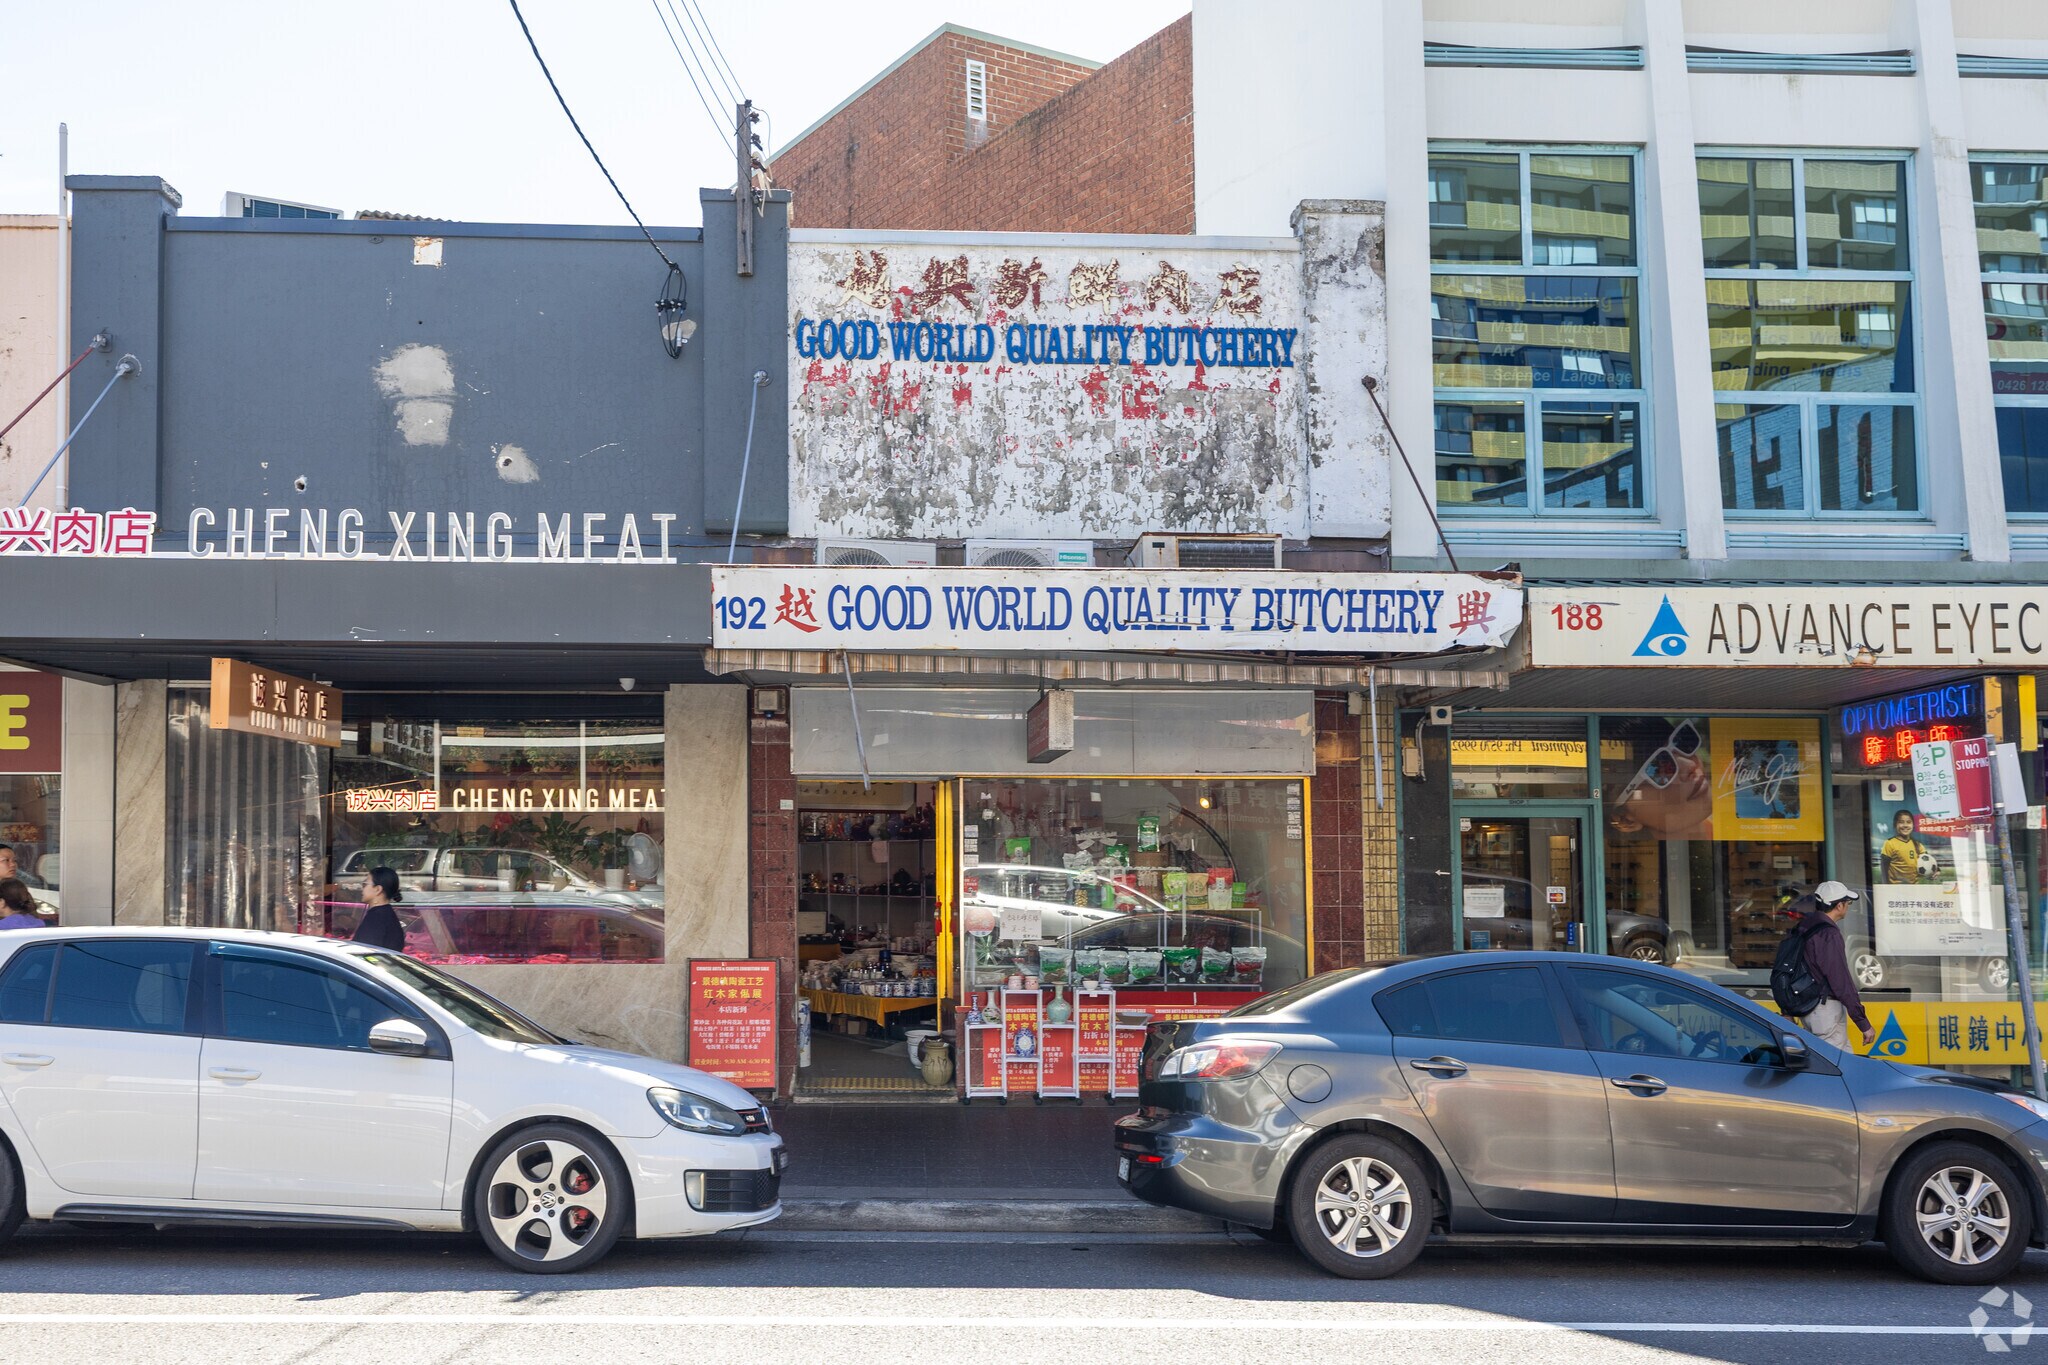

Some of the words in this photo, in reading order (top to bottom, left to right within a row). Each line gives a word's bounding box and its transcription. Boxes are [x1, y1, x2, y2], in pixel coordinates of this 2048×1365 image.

[1532, 291, 1612, 312] Learning
[1801, 295, 1878, 313] Tutoring
[1491, 319, 1528, 333] Math
[1559, 320, 1605, 334] Music
[796, 317, 880, 361] GOOD
[887, 320, 995, 363] WORLD
[1006, 322, 1134, 366] QUALITY
[1143, 325, 1298, 368] BUTCHERY
[1809, 330, 1871, 349] Writing
[1492, 345, 1516, 357] Art
[1493, 368, 1550, 382] Science
[1561, 369, 1633, 385] Language
[1719, 361, 1790, 379] Reading
[1811, 362, 1862, 378] Maths
[1997, 379, 2027, 391] 0426
[187, 507, 366, 559] CHENG
[388, 511, 513, 562] XING
[537, 512, 677, 563] MEAT
[1060, 553, 1087, 562] Hisense
[715, 596, 767, 630] 192
[773, 583, 823, 633] 越
[827, 584, 932, 632] GOOD
[942, 585, 1072, 632] WORLD
[1082, 585, 1242, 633] QUALITY
[1251, 587, 1445, 635] BUTCHERY
[1449, 589, 1497, 637] 興
[1551, 603, 1604, 631] 188
[1707, 603, 1913, 655] ADVANCE
[1933, 602, 2043, 655] EYEC
[1842, 685, 1972, 736] OPTOMETRIST
[1964, 743, 1981, 757] NO
[1956, 757, 1989, 771] STOPPING
[345, 788, 439, 811] 诚兴肉店
[452, 787, 534, 812] CHENG
[541, 787, 600, 812] XING
[1594, 790, 1600, 798] 2
